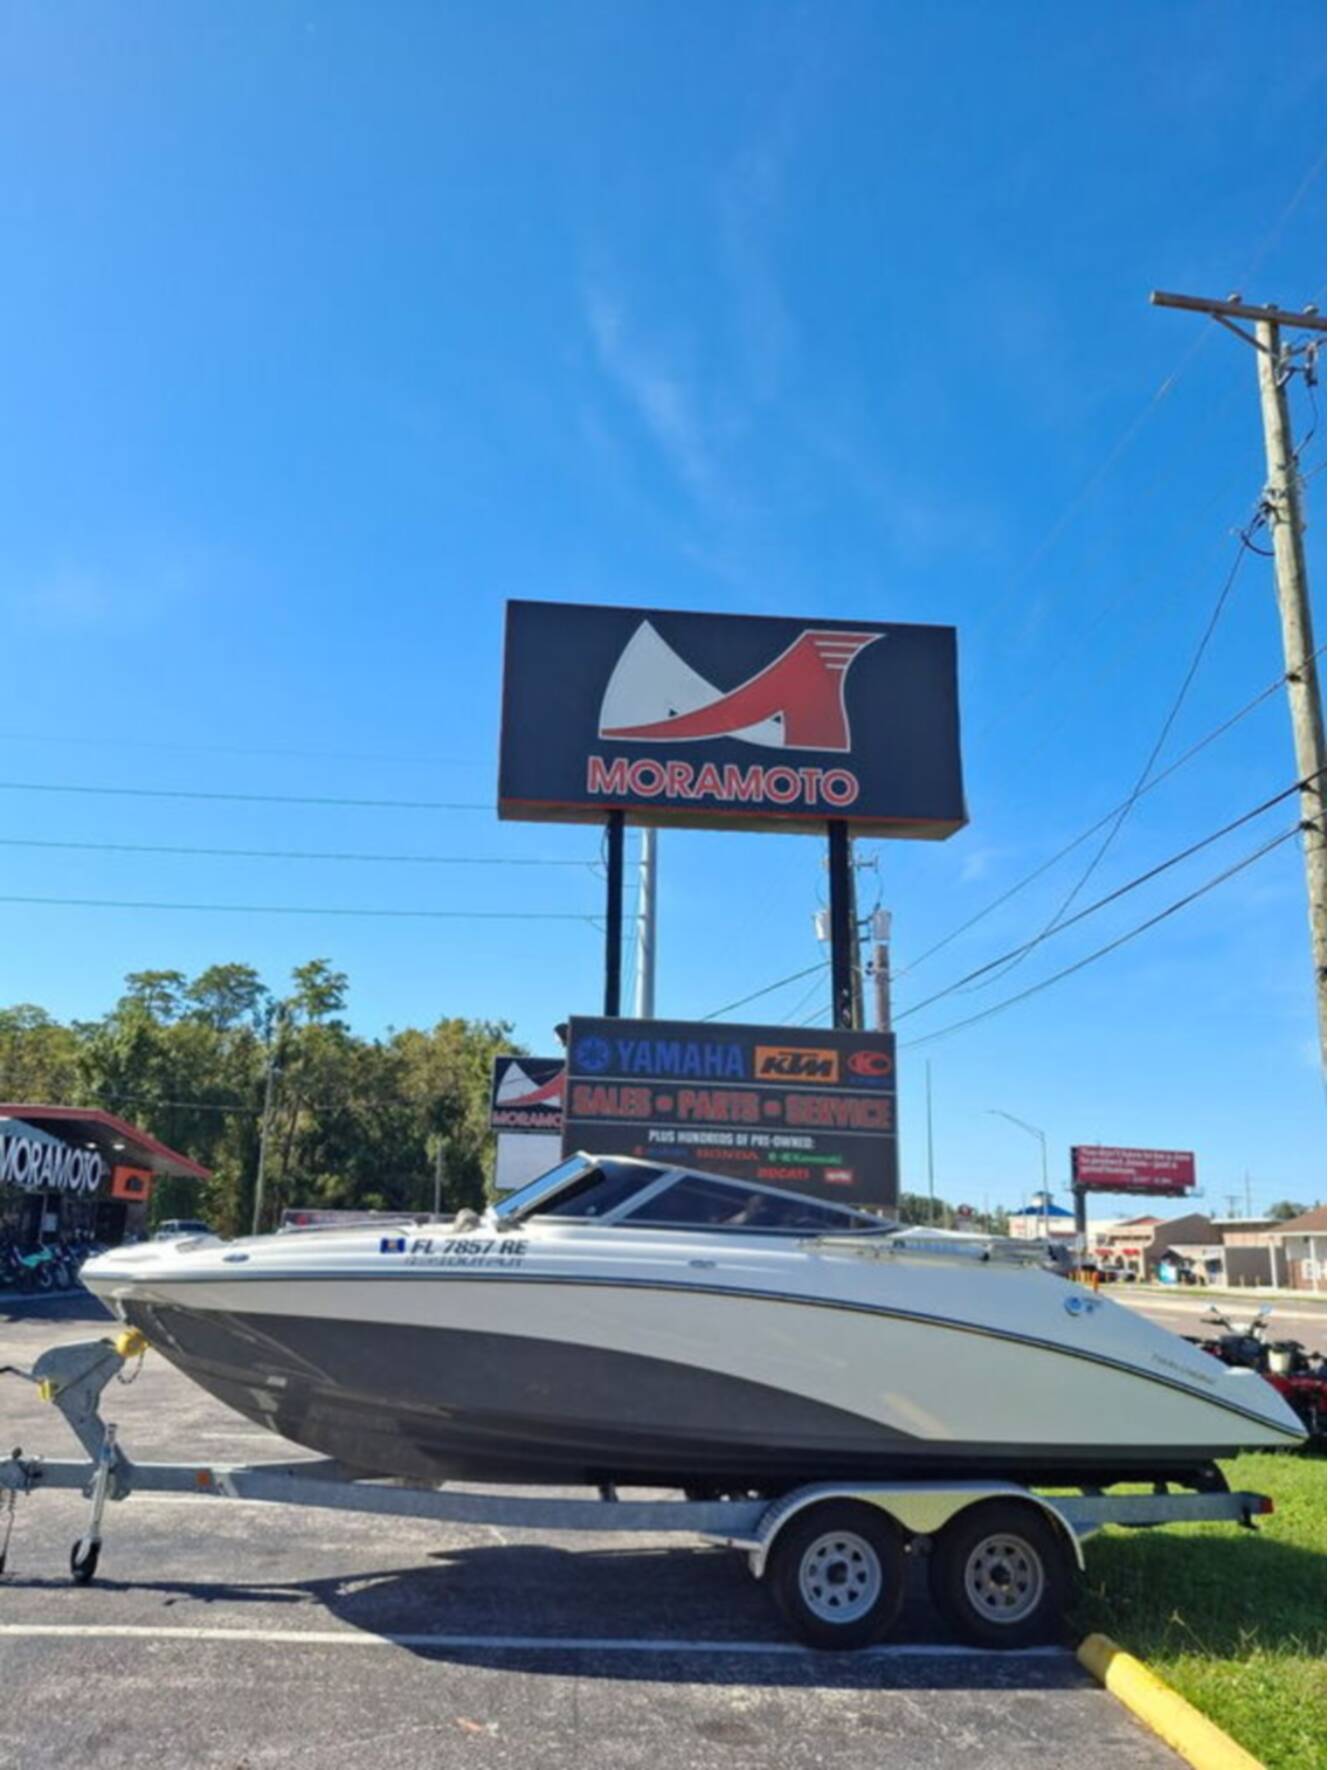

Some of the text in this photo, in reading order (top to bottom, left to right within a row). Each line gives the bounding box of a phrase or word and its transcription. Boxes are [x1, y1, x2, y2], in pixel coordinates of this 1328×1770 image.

[586, 755, 861, 807] MORAMOTO
[617, 1039, 746, 1078] YAMAHA
[760, 1052, 834, 1077] KTM
[573, 1085, 892, 1129] SALES PARTS SERVICE
[649, 1129, 675, 1142] PLUS
[410, 1239, 434, 1253] FL
[443, 1239, 494, 1253] 7857
